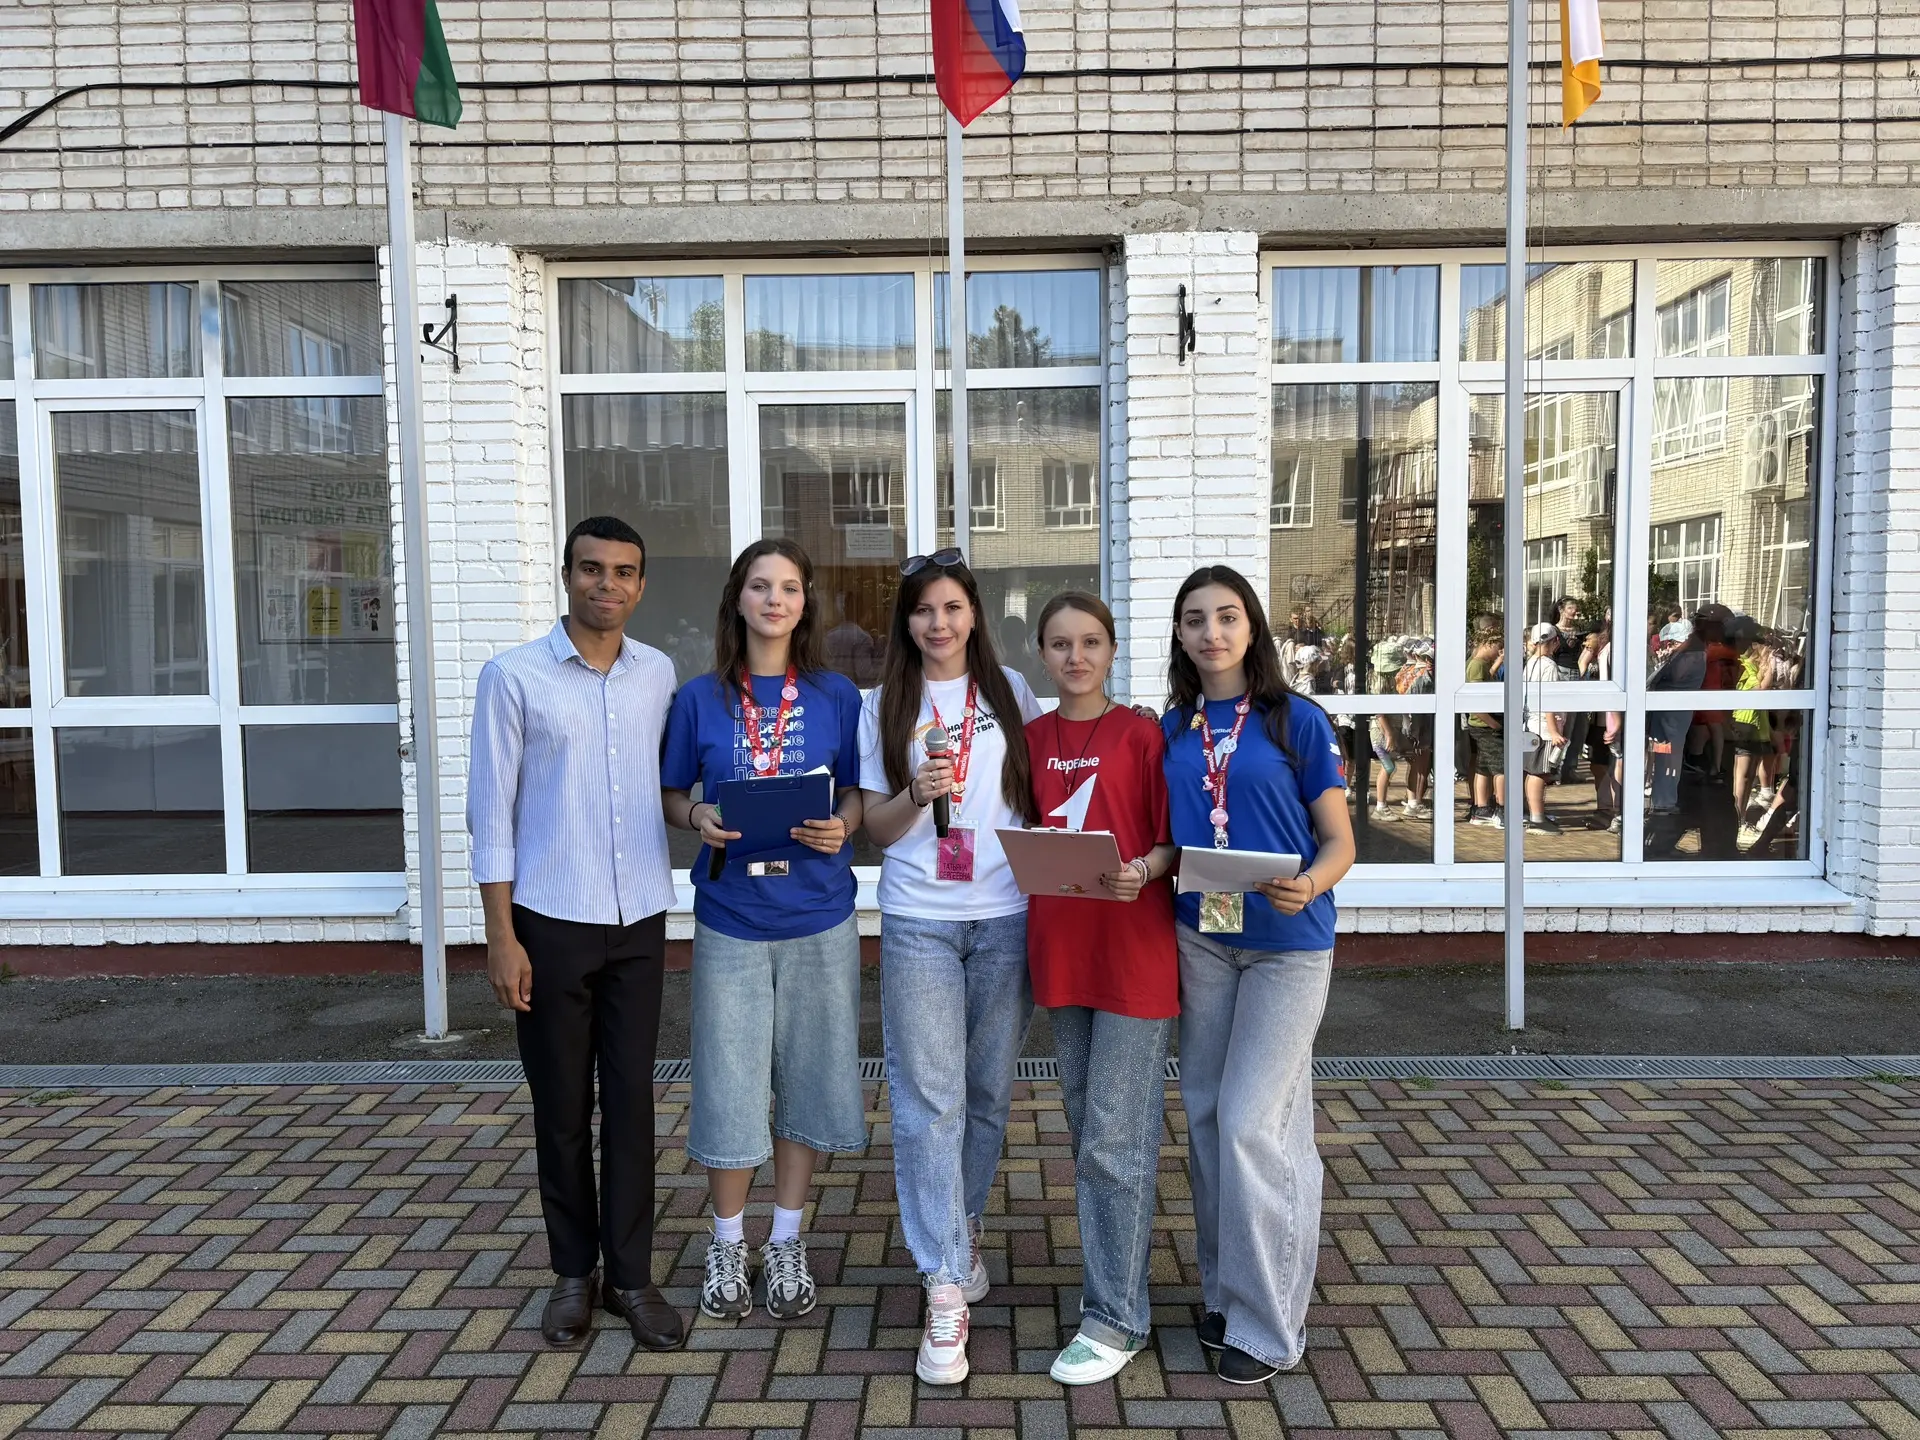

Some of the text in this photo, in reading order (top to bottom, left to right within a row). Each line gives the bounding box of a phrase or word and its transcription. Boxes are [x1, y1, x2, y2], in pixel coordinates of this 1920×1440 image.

[260, 506, 345, 525] ИТОГОВАЯ
[959, 751, 970, 779] Первые
[1047, 756, 1100, 774] Первые
